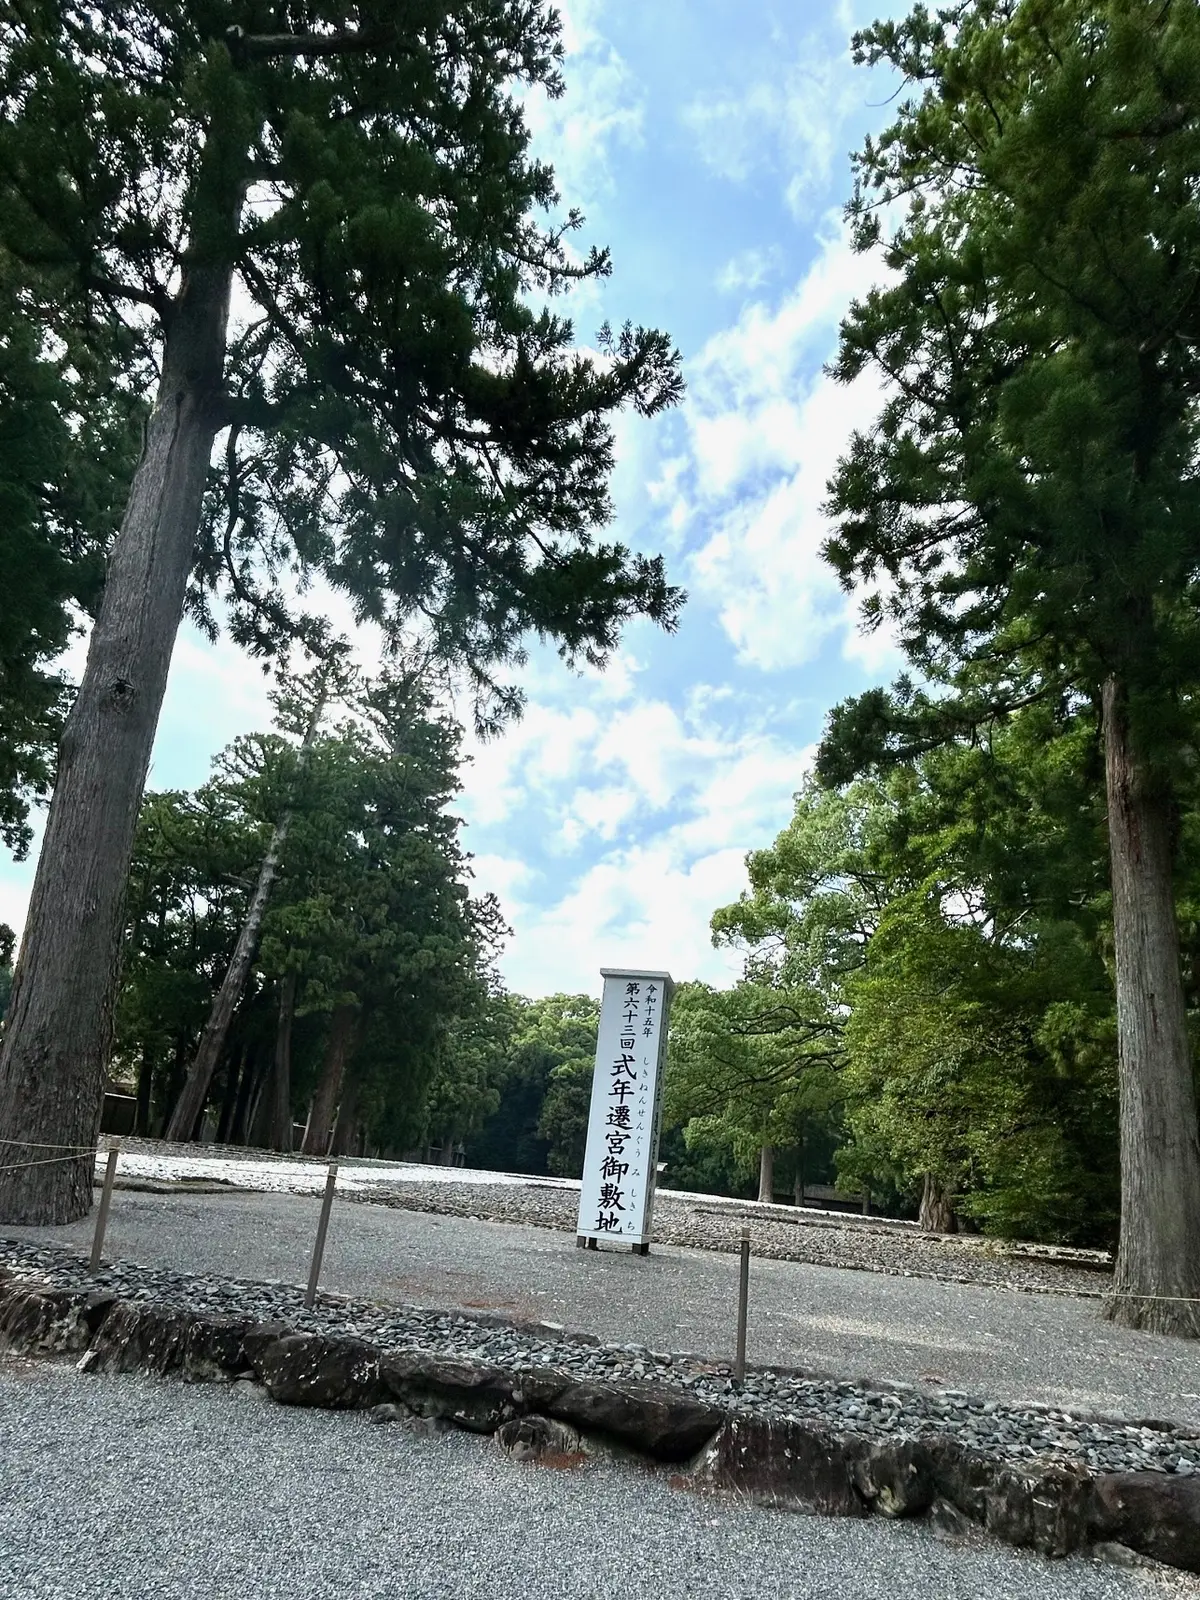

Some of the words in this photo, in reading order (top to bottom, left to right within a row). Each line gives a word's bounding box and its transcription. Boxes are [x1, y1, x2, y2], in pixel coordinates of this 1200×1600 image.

[642, 984, 657, 1038] 令和十五年
